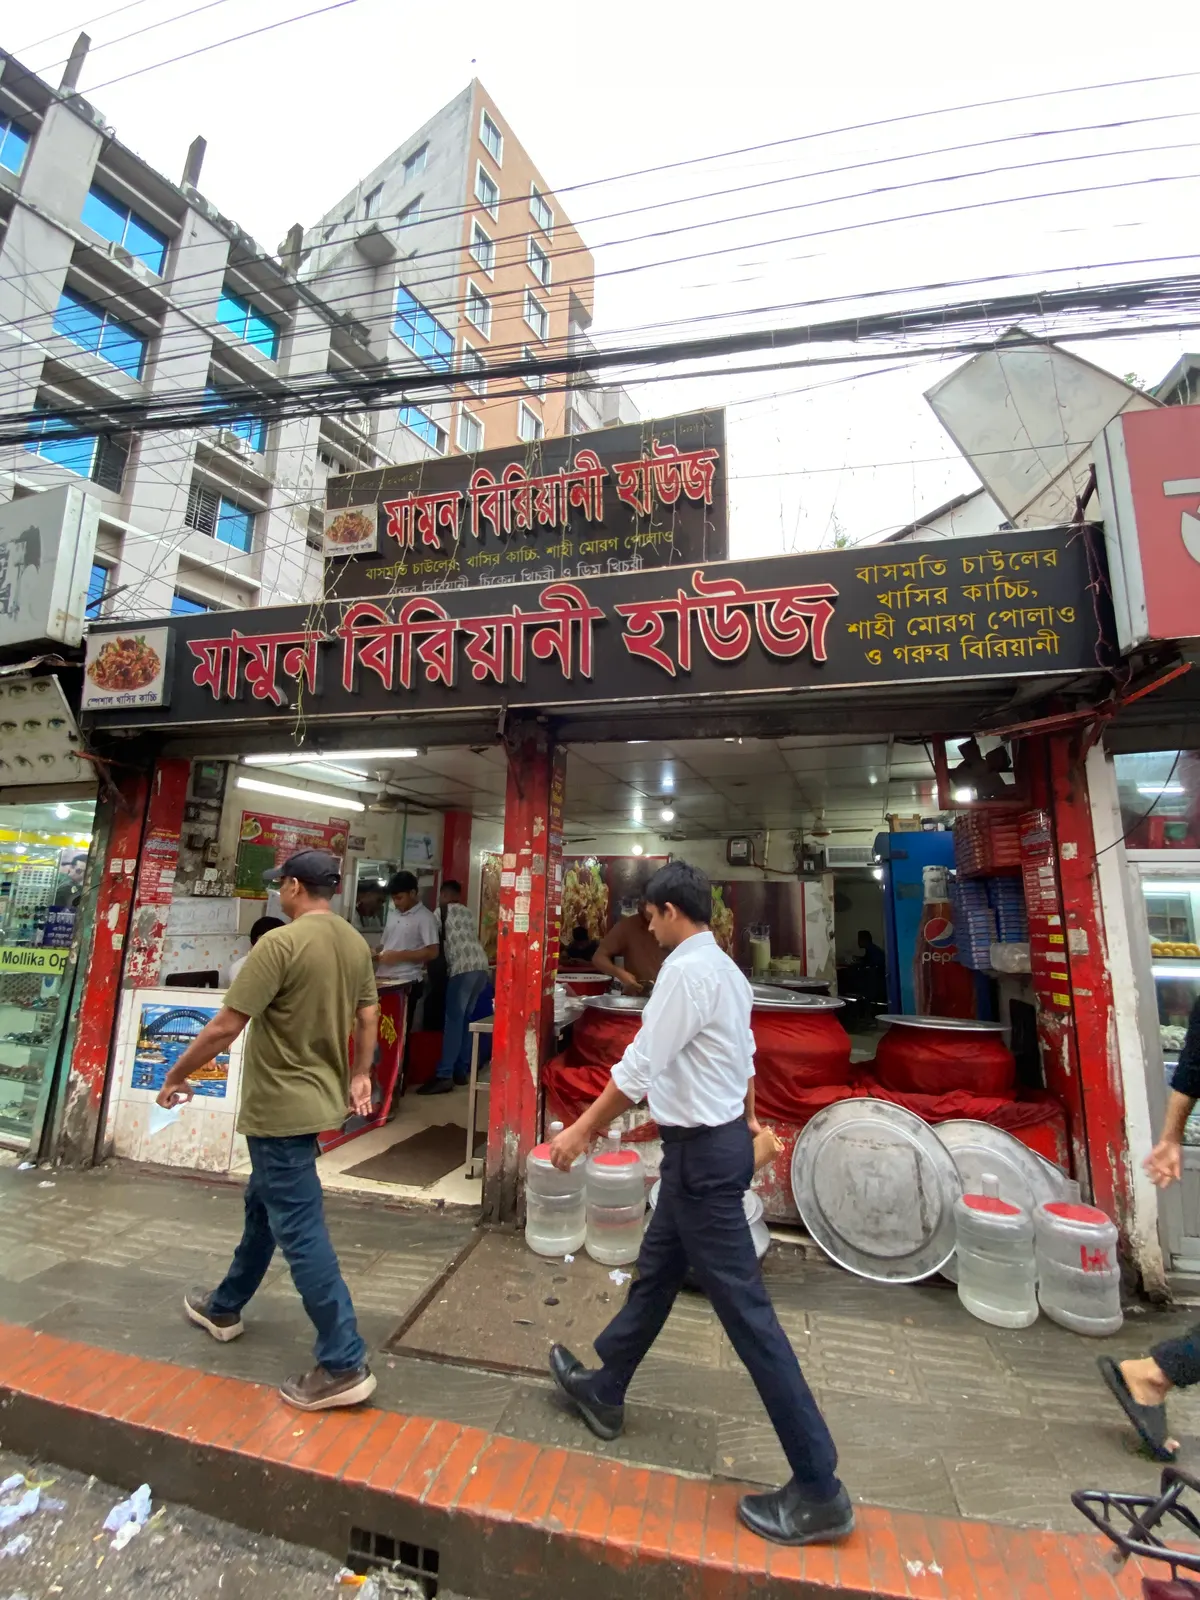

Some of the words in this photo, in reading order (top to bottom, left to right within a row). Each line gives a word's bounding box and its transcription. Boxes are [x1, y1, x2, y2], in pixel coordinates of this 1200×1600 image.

[383, 490, 463, 549] মামুন
[469, 449, 609, 538] বিরিয়ানী
[614, 440, 719, 516] হাউজ
[466, 551, 500, 568] খাসির
[546, 540, 573, 558] শাহী
[579, 536, 619, 555] মোরগ
[855, 554, 948, 584] বাসমতি
[960, 549, 1058, 574] চাউলের
[876, 583, 948, 609] খাসির
[187, 630, 335, 706] মামুন
[338, 584, 606, 690] বিরিয়ানী
[614, 570, 839, 677] হাউজ
[846, 613, 896, 640] শাহী
[907, 611, 976, 636] মোরগ
[988, 605, 1076, 630] পোলাও
[864, 648, 882, 665] ও
[893, 643, 951, 664] গরুর
[960, 628, 1060, 660] বিরিয়ানী
[2, 951, 45, 967] Mollika
[922, 950, 956, 965] pep
